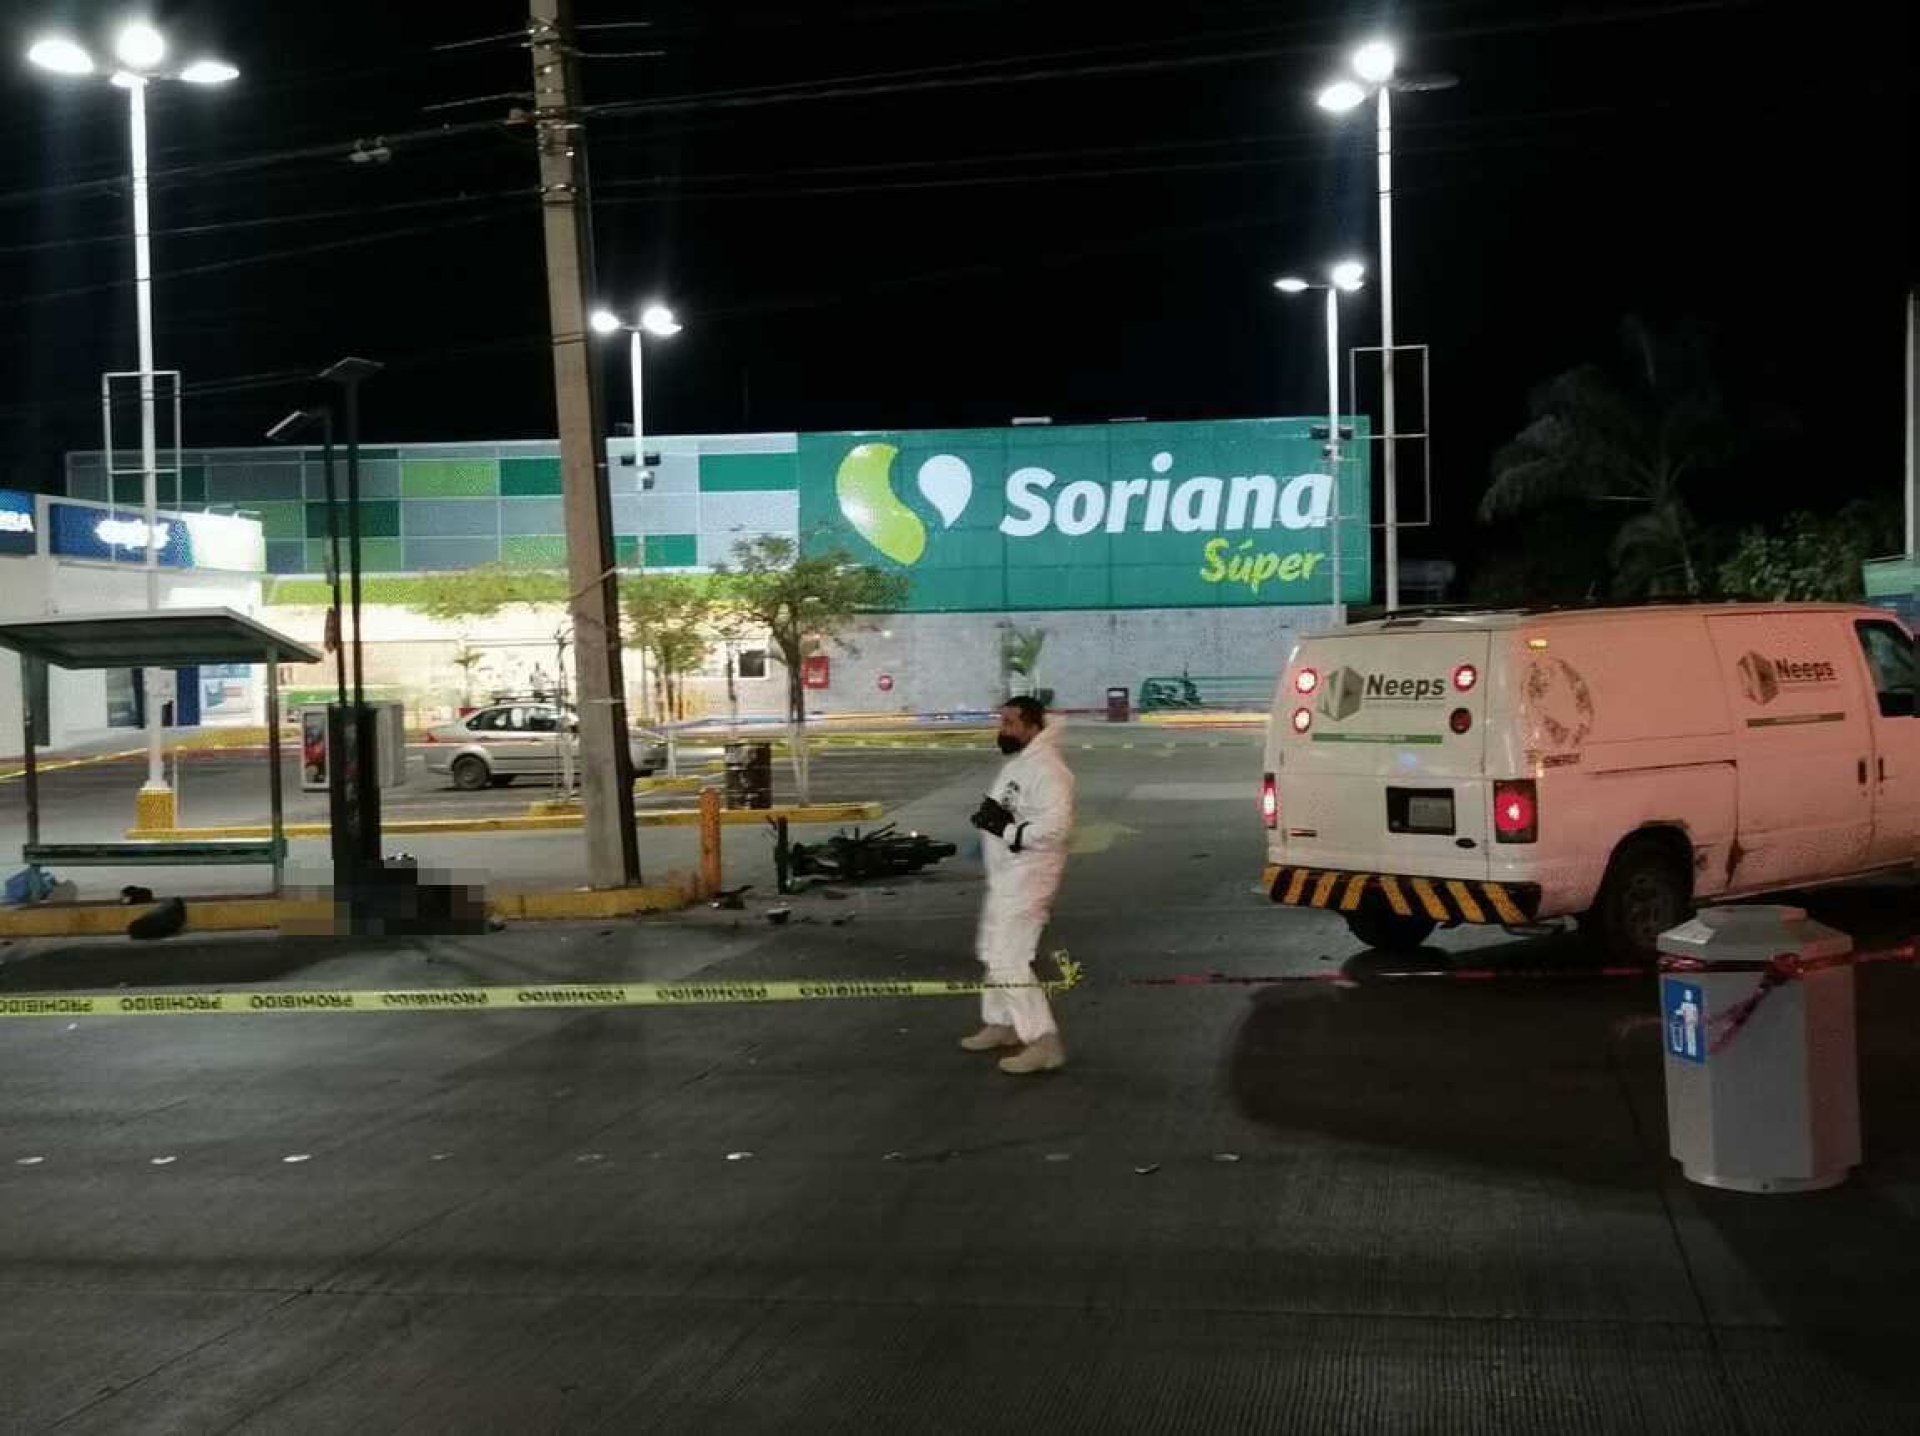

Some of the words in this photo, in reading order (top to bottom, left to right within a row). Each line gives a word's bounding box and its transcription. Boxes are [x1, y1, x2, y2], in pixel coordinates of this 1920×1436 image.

[1000, 451, 1335, 537] Soriana
[1201, 538, 1325, 597] Súper
[1775, 658, 1836, 681] Neeps
[1366, 674, 1446, 701] Neeps
[120, 996, 223, 1011] PROHIBIDO
[251, 994, 354, 1009] PROHIBIDO
